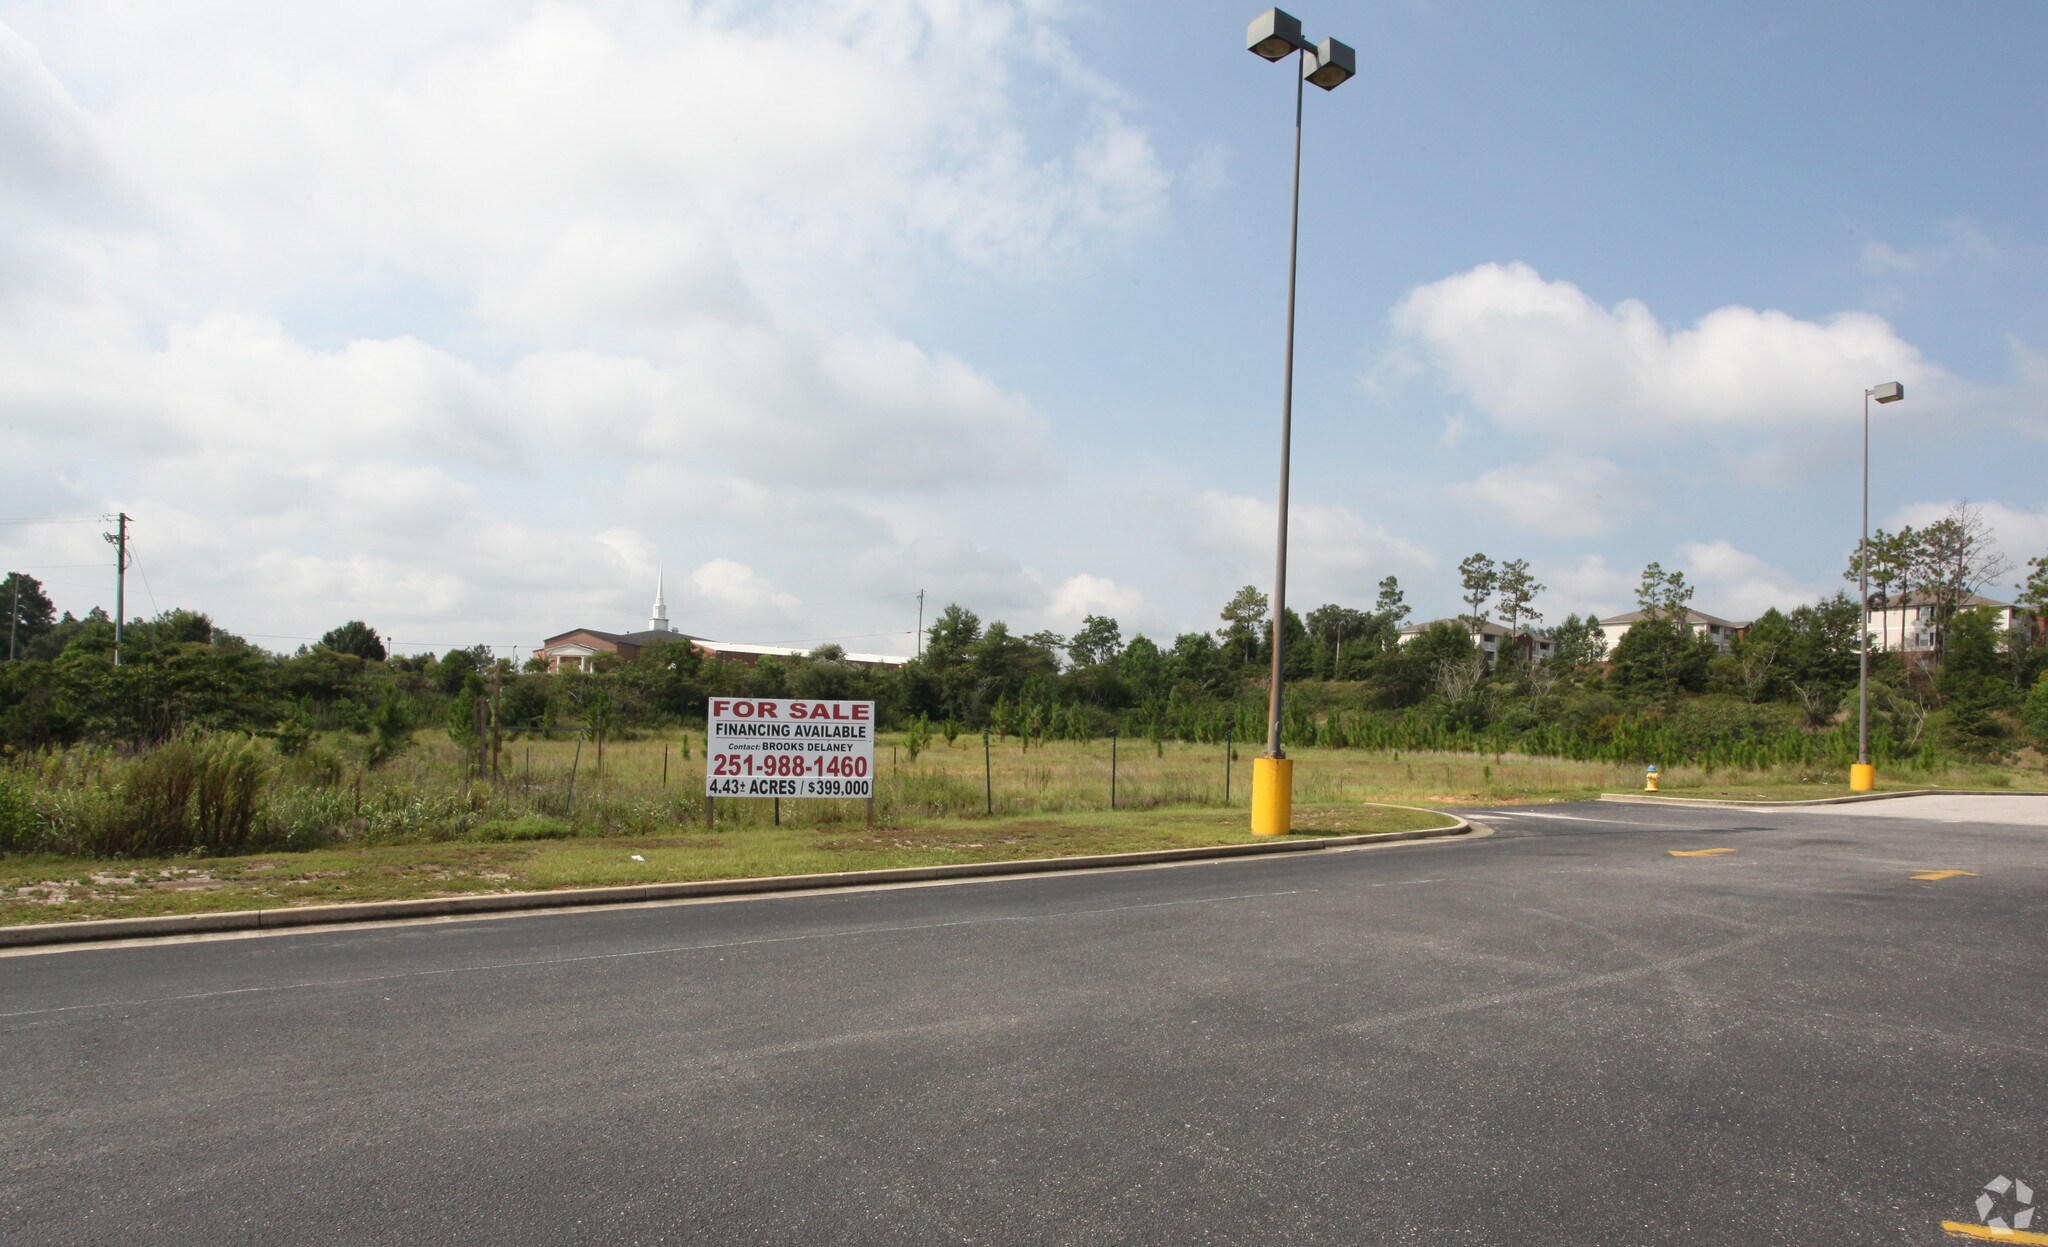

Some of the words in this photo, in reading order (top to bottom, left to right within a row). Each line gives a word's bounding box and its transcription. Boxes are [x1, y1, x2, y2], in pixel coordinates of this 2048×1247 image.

[713, 701, 777, 718] FOR
[789, 703, 869, 720] SALE
[716, 723, 790, 737] FINANCING
[794, 725, 866, 738] AVAILABLE
[728, 743, 761, 751] Contact:
[762, 742, 804, 751] BROOKS
[807, 743, 853, 752] DELANEY
[713, 754, 867, 777] 251-988-1460
[749, 779, 796, 795] ACRES
[808, 780, 869, 796] $399,000
